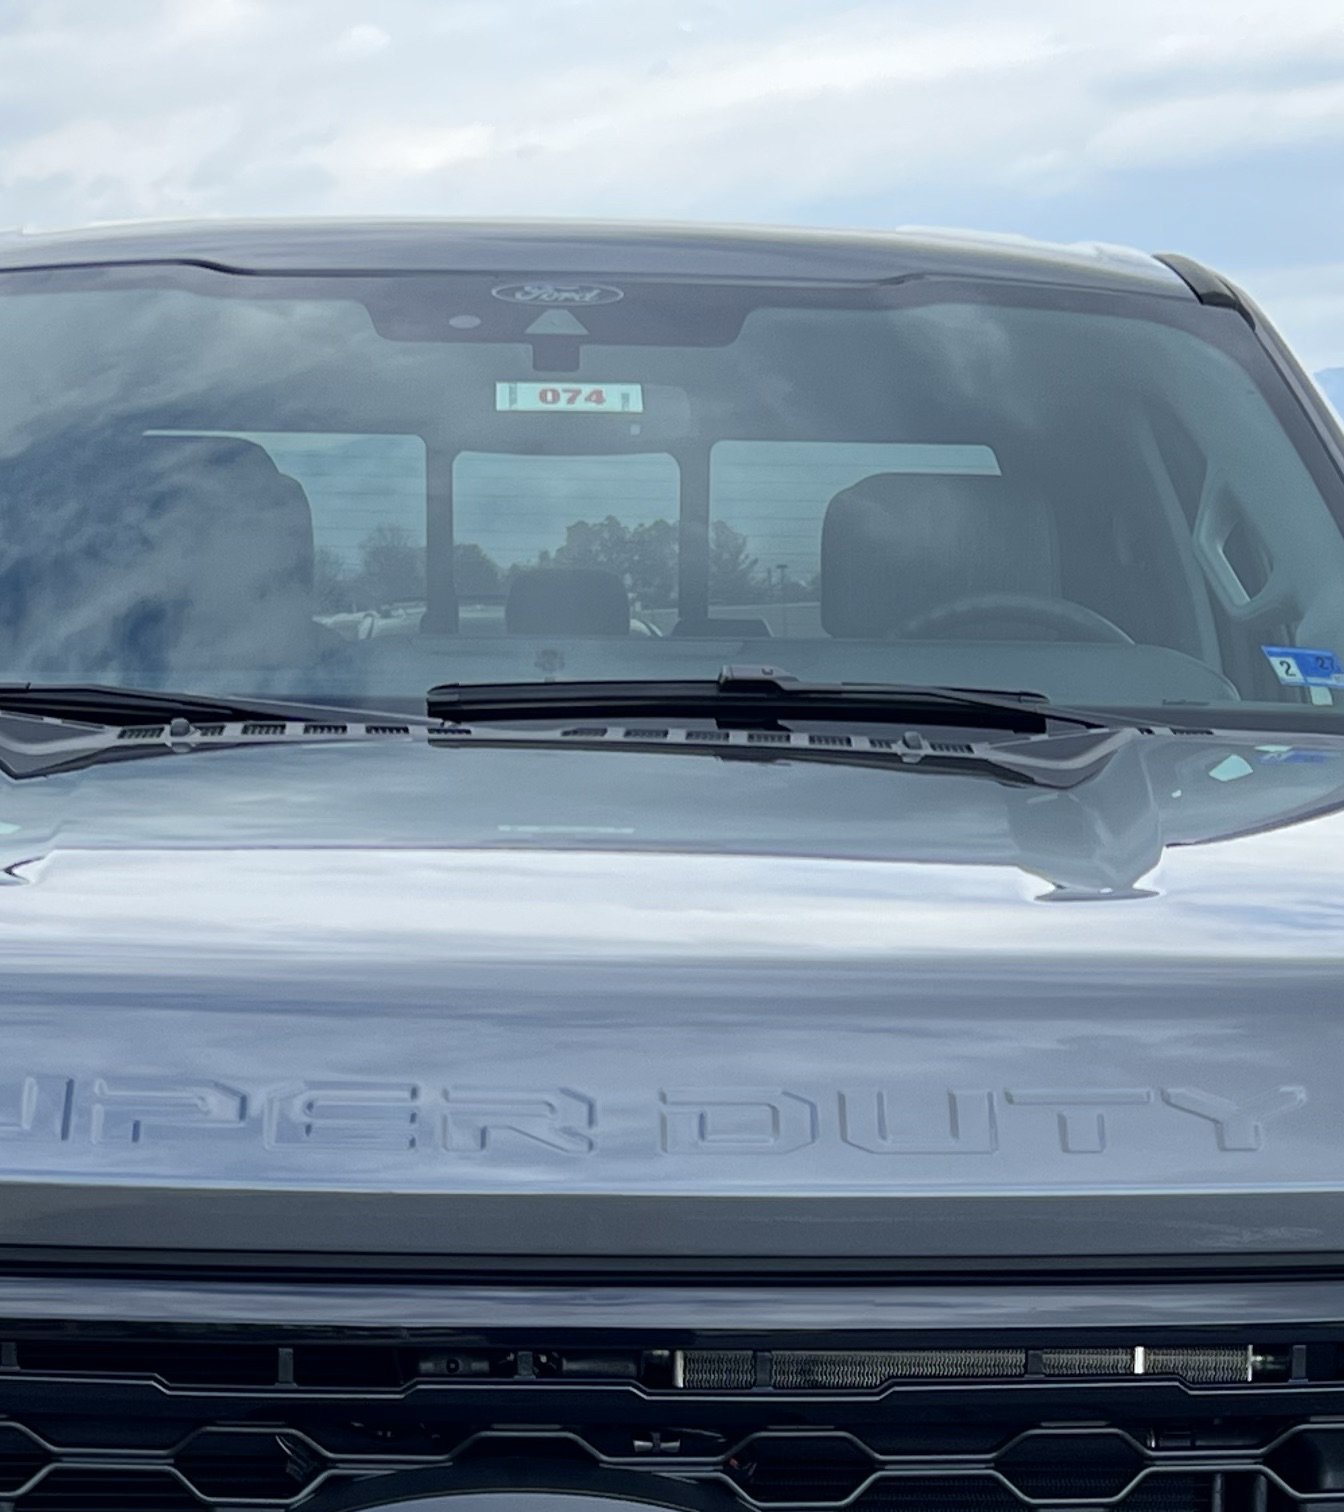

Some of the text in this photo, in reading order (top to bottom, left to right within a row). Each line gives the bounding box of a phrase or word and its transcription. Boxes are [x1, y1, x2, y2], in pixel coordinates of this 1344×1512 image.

[514, 285, 602, 301] Ford
[538, 388, 606, 405] 074
[1279, 660, 1297, 677] 2
[659, 1086, 1307, 1154] DUTY
